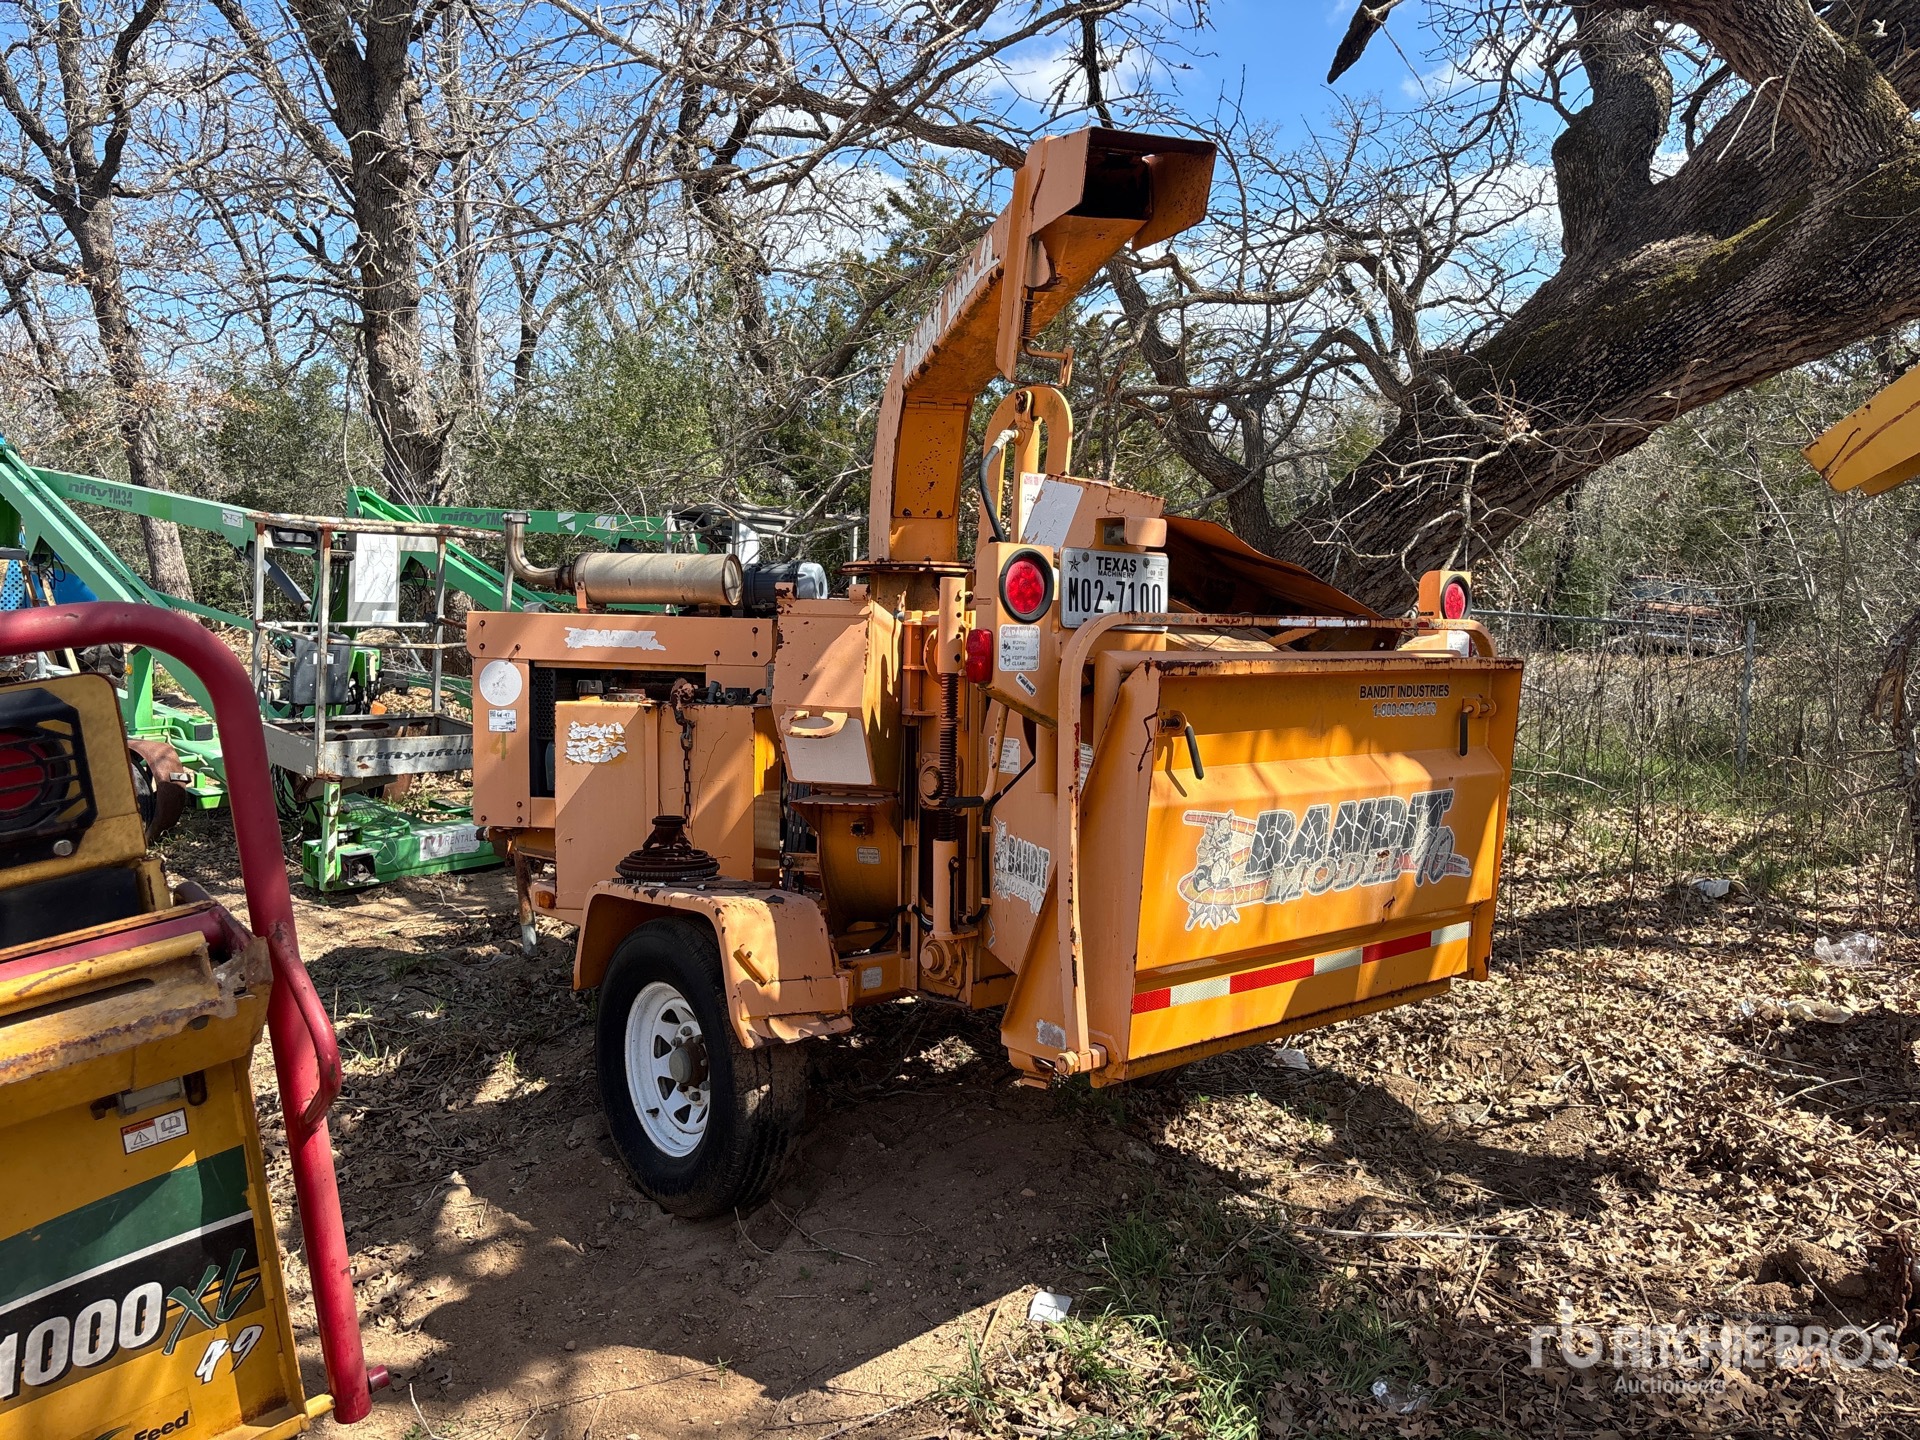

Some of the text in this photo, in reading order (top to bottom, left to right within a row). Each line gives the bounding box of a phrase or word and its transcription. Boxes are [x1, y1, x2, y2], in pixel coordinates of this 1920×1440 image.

[1096, 556, 1137, 573] TEXAS
[1097, 569, 1135, 579] MACHINERY
[1360, 685, 1450, 699] BANDIT INDUSTRIES
[1244, 790, 1453, 880] BANDIT
[134, 1410, 189, 1440] Feed
